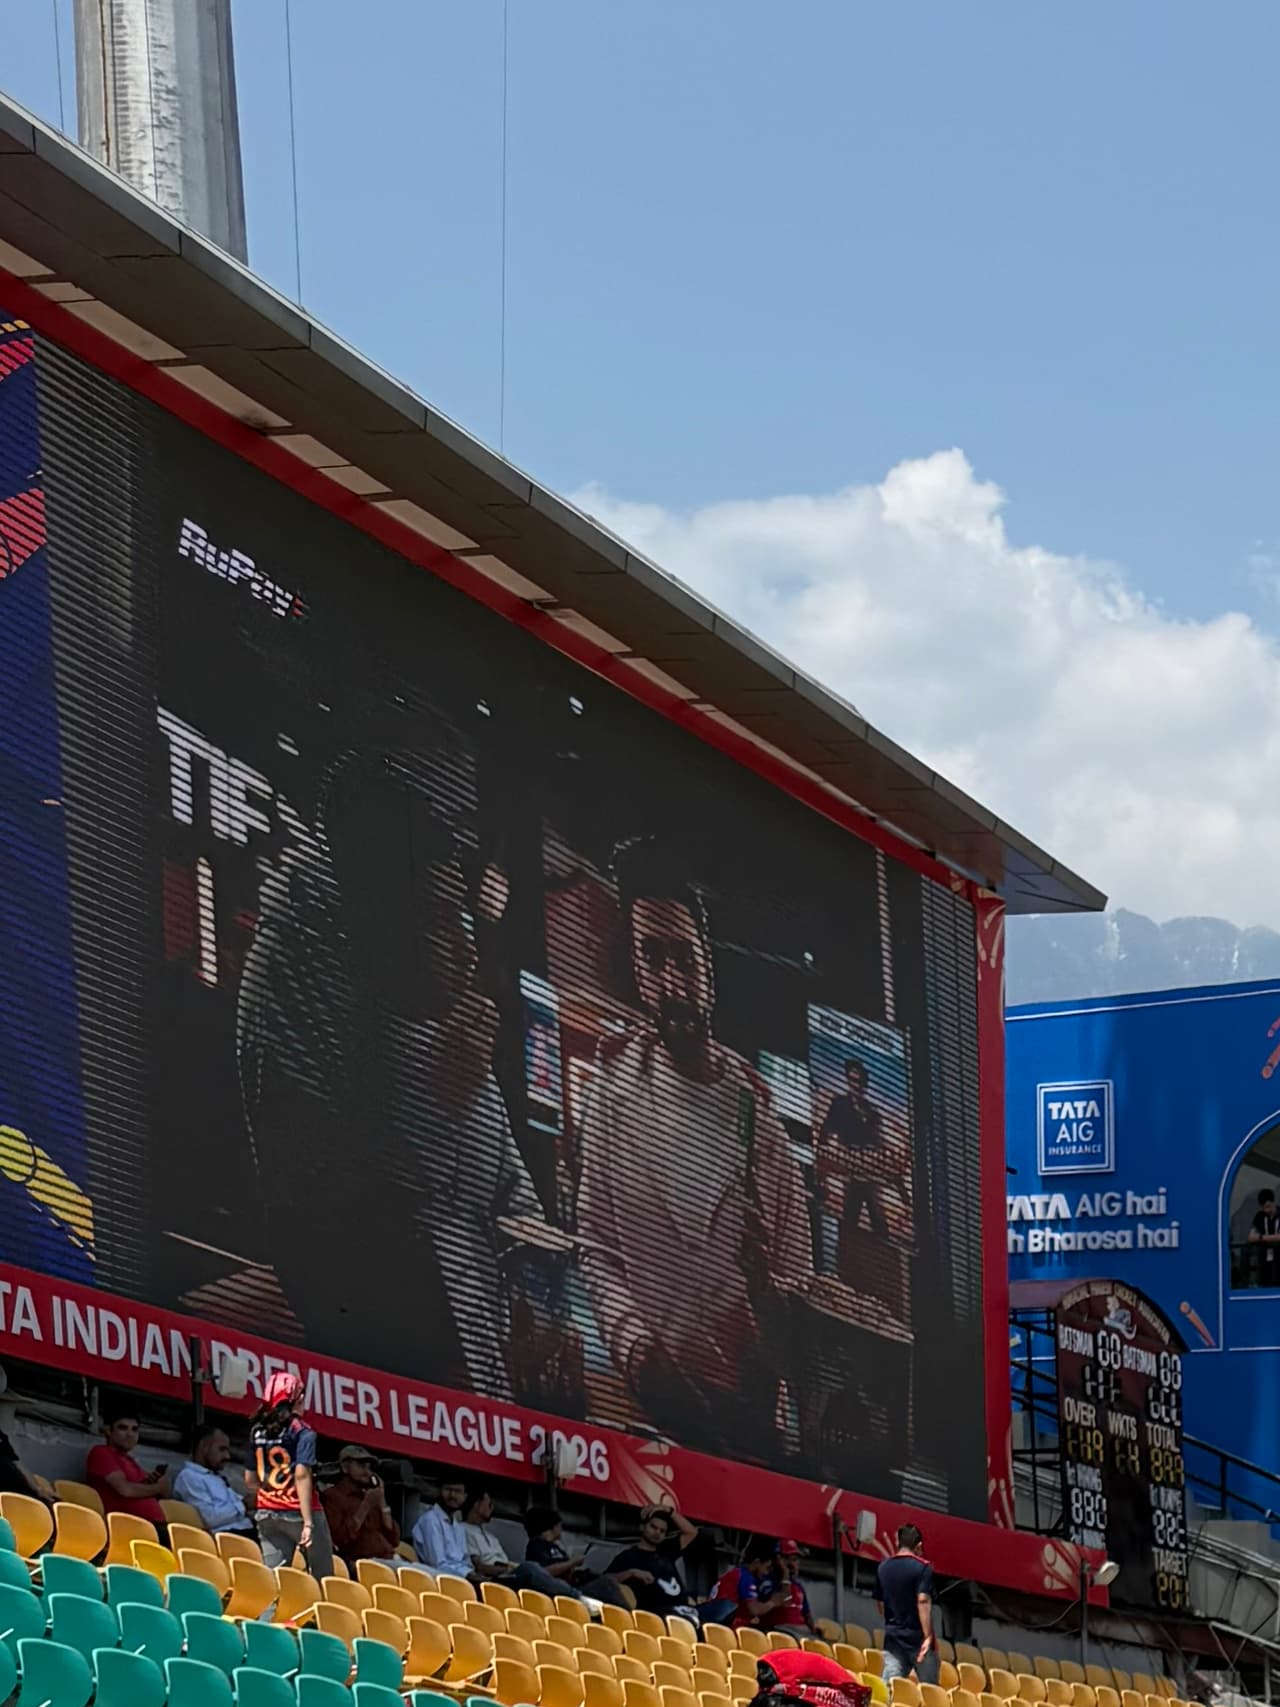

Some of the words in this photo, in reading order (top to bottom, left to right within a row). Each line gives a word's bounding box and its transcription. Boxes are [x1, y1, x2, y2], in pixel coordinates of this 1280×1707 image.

[179, 518, 293, 617] RuPay
[1048, 1100, 1100, 1120] TATA
[1056, 1122, 1094, 1143] AIG
[1048, 1143, 1102, 1156] INSURANCE
[1075, 1191, 1122, 1217] AIG
[1126, 1187, 1166, 1216] hai
[1028, 1226, 1132, 1254] Bharosa
[1137, 1222, 1179, 1249] hai
[52, 1295, 193, 1378] INDIAN
[390, 1389, 526, 1461] LEAGUE
[1064, 1397, 1096, 1428] OVER
[1107, 1410, 1137, 1440] WKTS
[1145, 1422, 1181, 1452] TOTAL
[256, 1445, 292, 1489] 18
